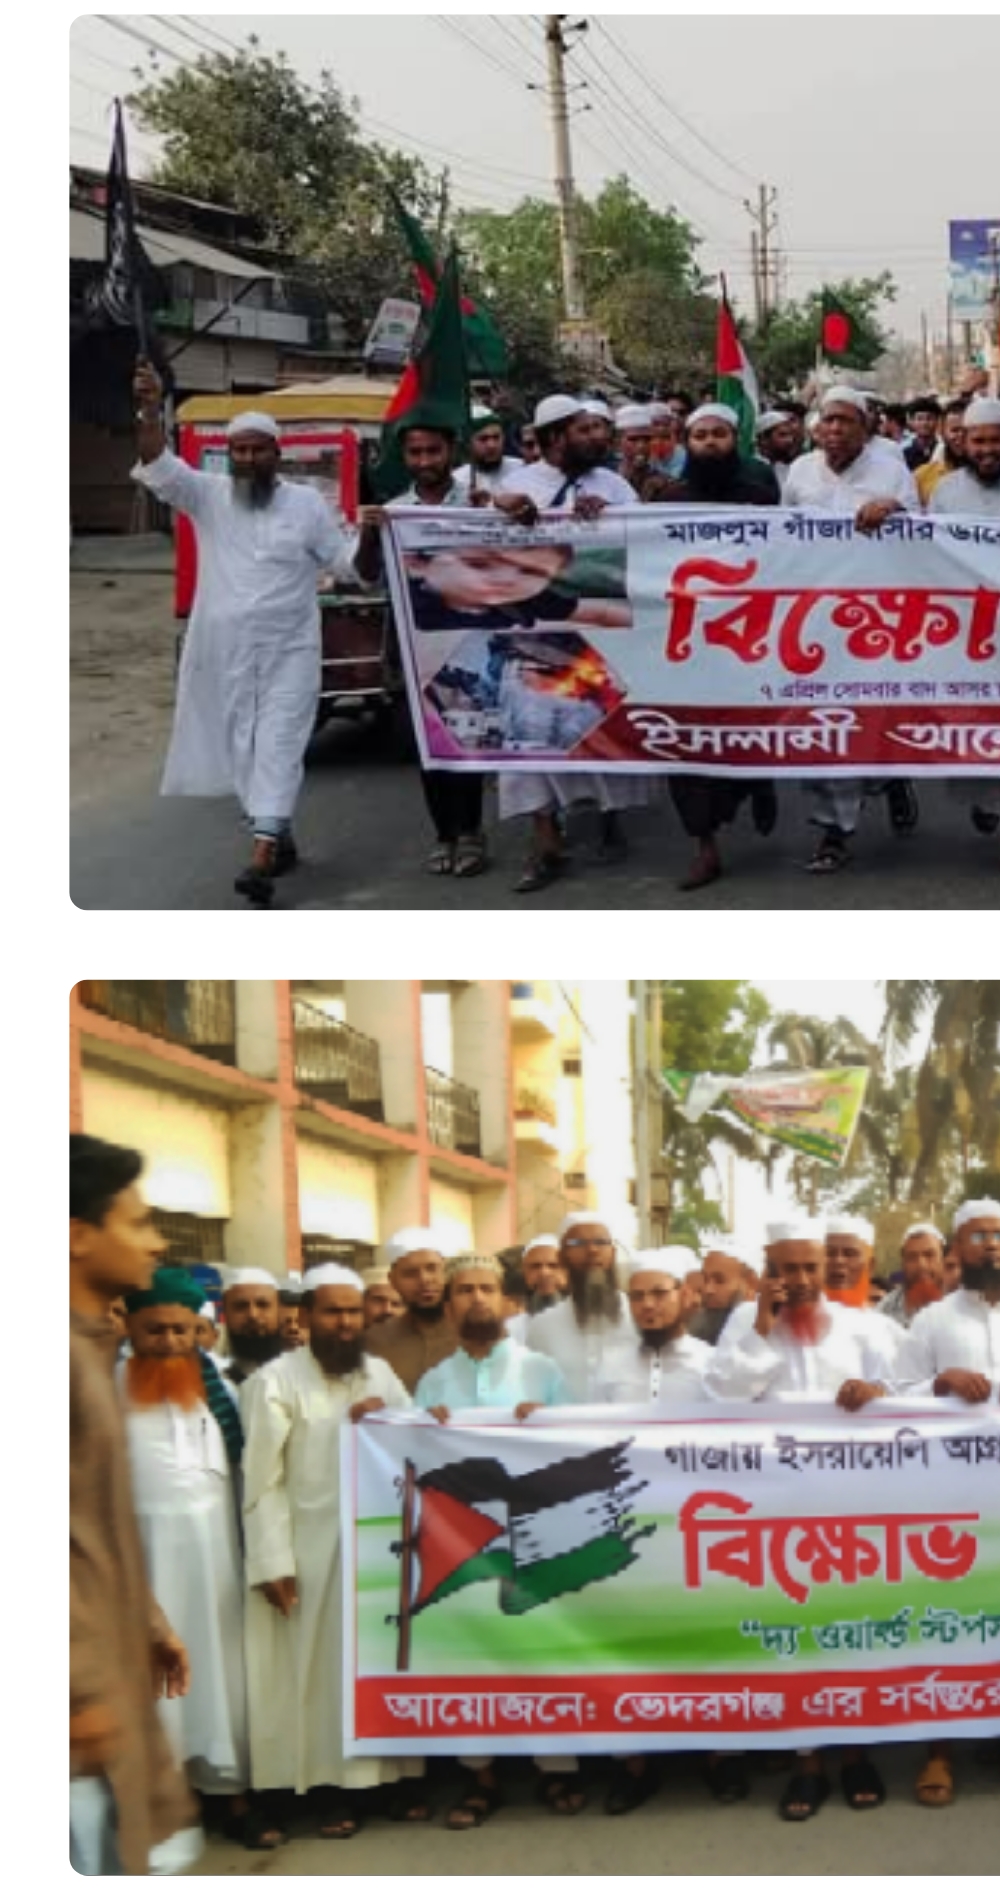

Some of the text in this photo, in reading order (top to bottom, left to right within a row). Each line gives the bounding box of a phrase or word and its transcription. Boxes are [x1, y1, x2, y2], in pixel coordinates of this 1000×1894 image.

[665, 519, 769, 546] মাজলুম
[626, 708, 862, 758] ইসলামী
[664, 1439, 763, 1472] গাজায়
[678, 1489, 980, 1604] বিক্ষোভ
[802, 1684, 866, 1718] এর
